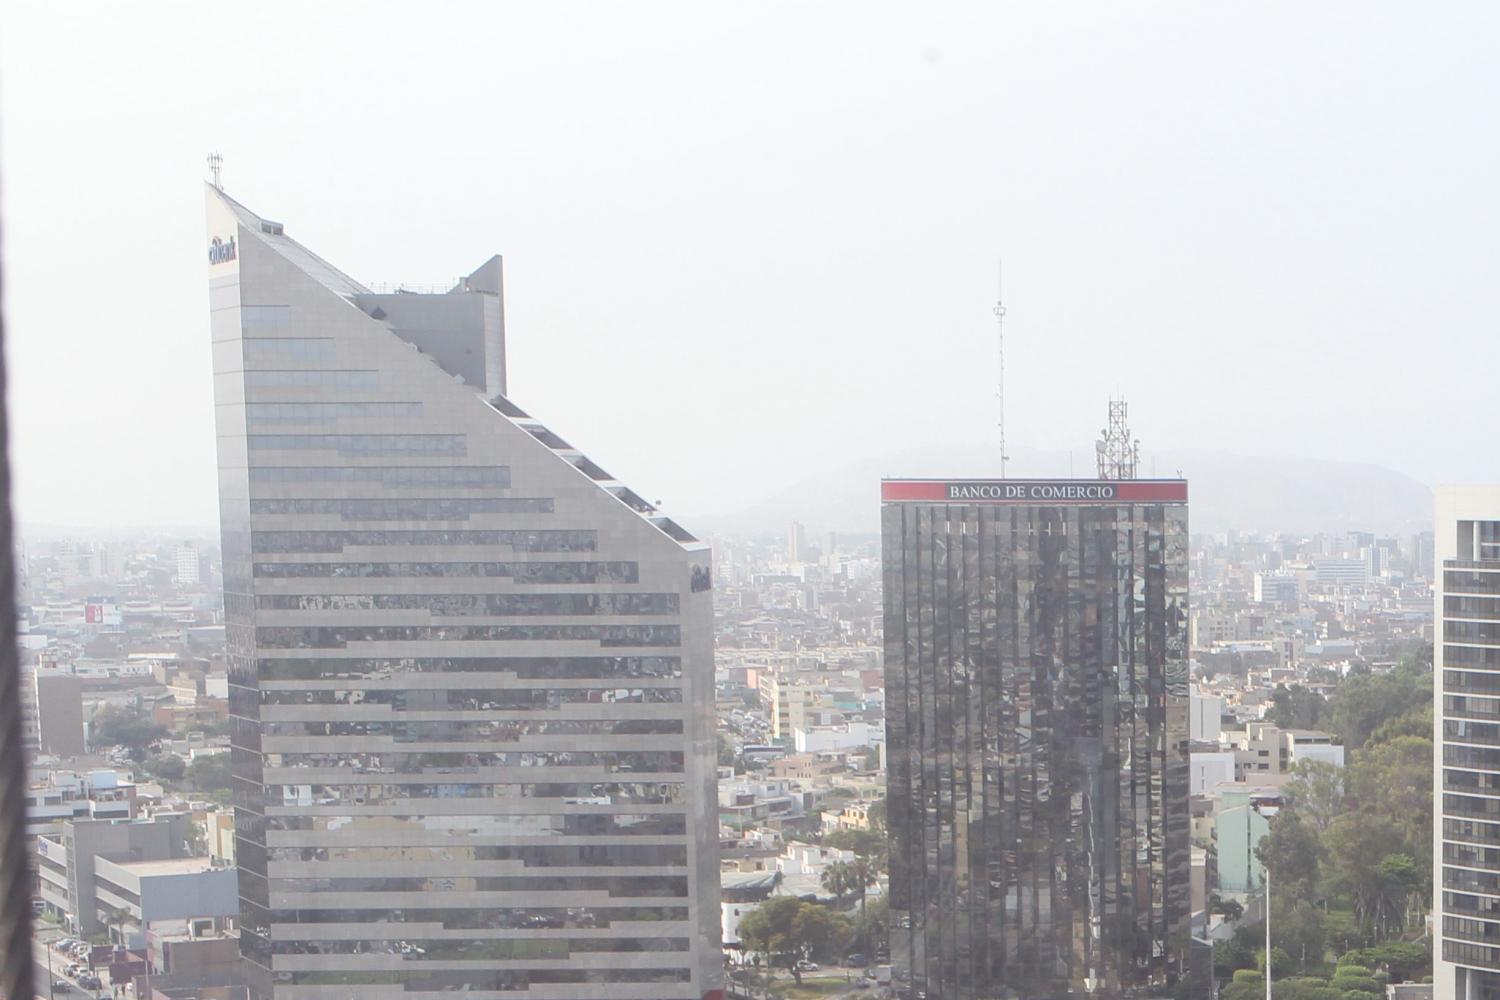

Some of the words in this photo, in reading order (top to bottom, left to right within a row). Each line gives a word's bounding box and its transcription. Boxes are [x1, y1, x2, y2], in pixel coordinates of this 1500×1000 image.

[949, 485, 1001, 499] BANCO
[1005, 485, 1027, 499] DE
[1030, 485, 1114, 499] COMERCIO
